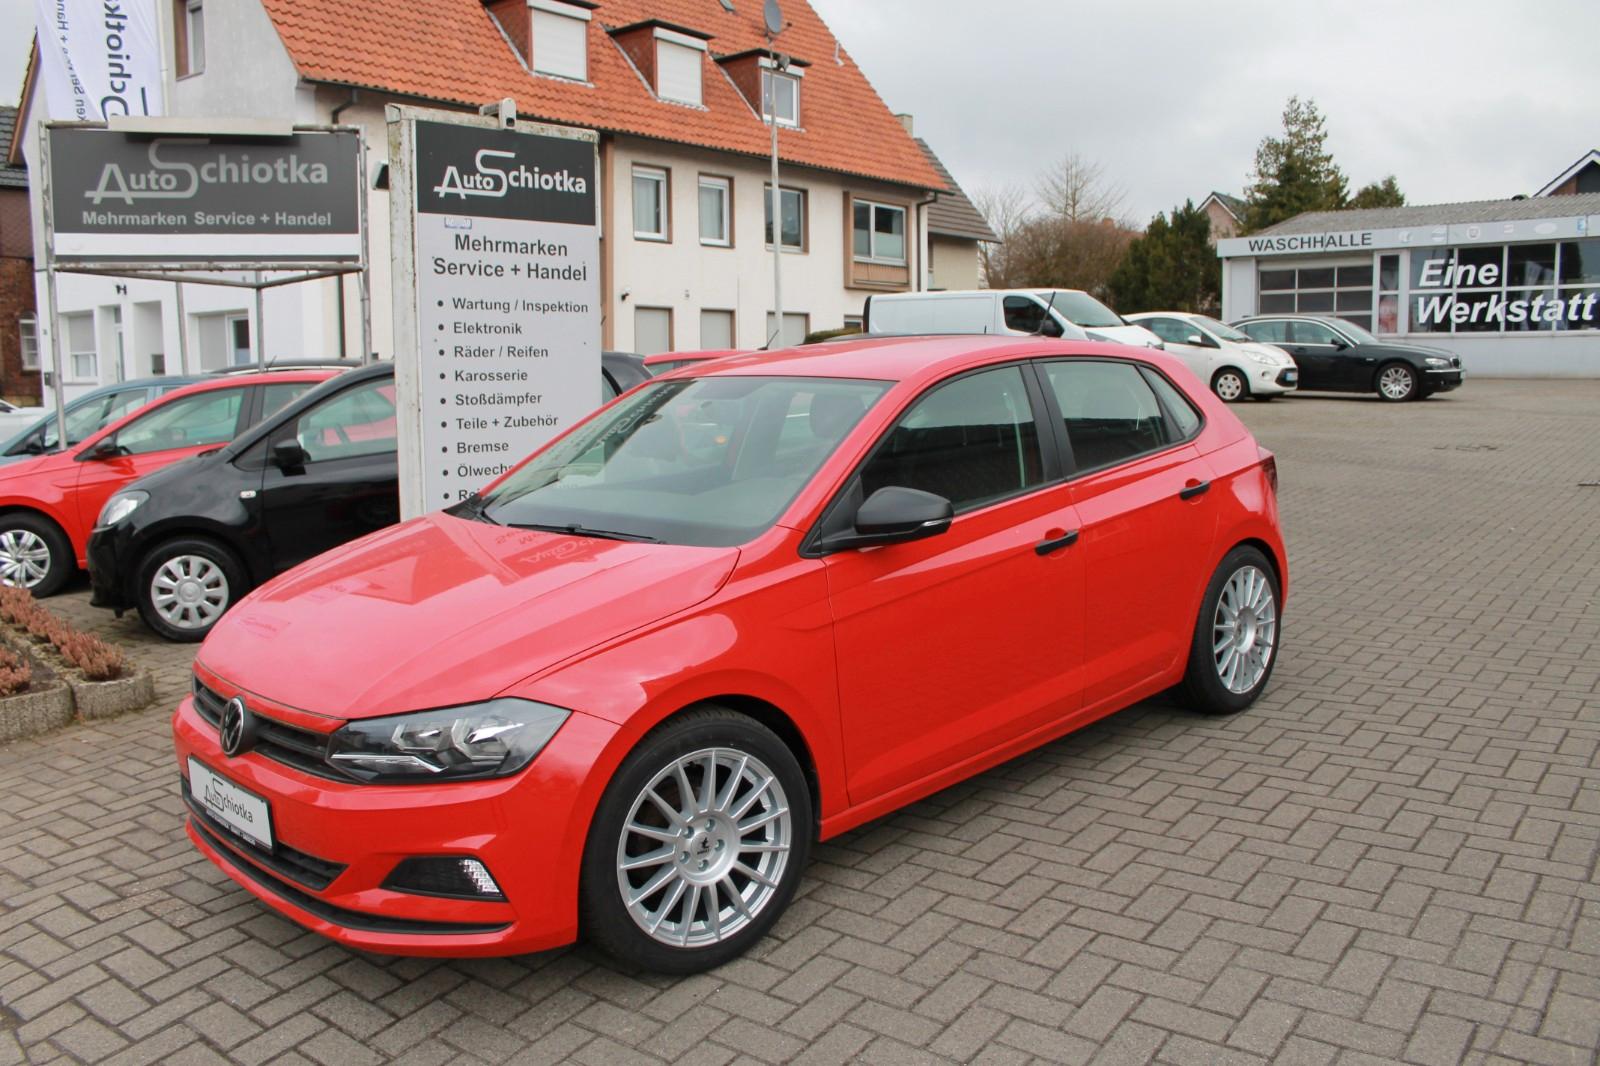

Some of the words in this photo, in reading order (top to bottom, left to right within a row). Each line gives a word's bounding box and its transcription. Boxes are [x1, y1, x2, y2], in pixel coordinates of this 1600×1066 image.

[82, 211, 187, 226] Mehrmarken
[194, 211, 255, 226] Service
[260, 213, 269, 225] +
[275, 211, 331, 226] Handel
[454, 233, 568, 257] Mehrmarken
[1248, 232, 1373, 252] WASCHHALLE
[433, 257, 504, 277] Service
[510, 264, 521, 276] +
[527, 262, 587, 281] Handel
[1418, 258, 1500, 288] Eine
[452, 297, 510, 313] Wartung
[522, 300, 588, 315] Inspektion
[1417, 292, 1597, 325] Werkstatt
[453, 321, 522, 335] Elektronik
[454, 345, 495, 358] Räder
[507, 345, 549, 358] Reifen
[454, 369, 528, 382] Karosserie
[455, 392, 542, 406] Stoßdämpfer
[456, 417, 488, 430] Teile
[503, 415, 559, 428] Zubehör
[456, 441, 509, 454] Bremse
